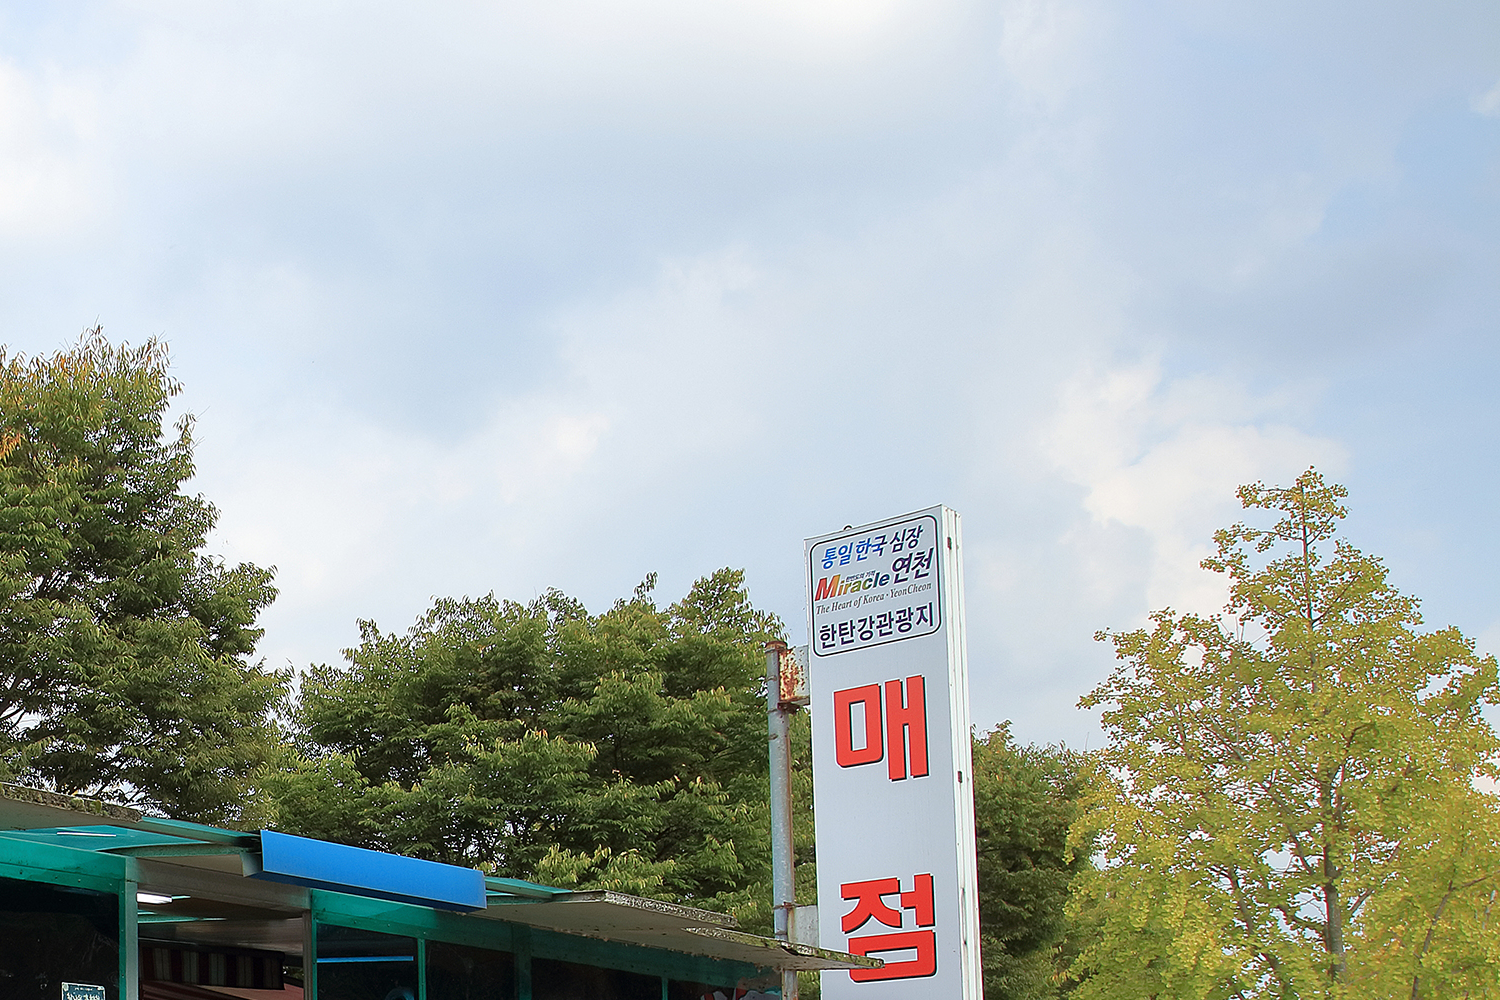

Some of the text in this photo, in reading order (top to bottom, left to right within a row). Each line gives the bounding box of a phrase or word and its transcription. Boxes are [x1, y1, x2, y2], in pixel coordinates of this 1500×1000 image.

[821, 525, 924, 569] 통일 한국 심장
[892, 547, 935, 584] 연천
[815, 572, 890, 601] Miracle
[816, 582, 932, 615] The Heart of Korea YeonCheon
[819, 601, 934, 649] 한탄강관광지
